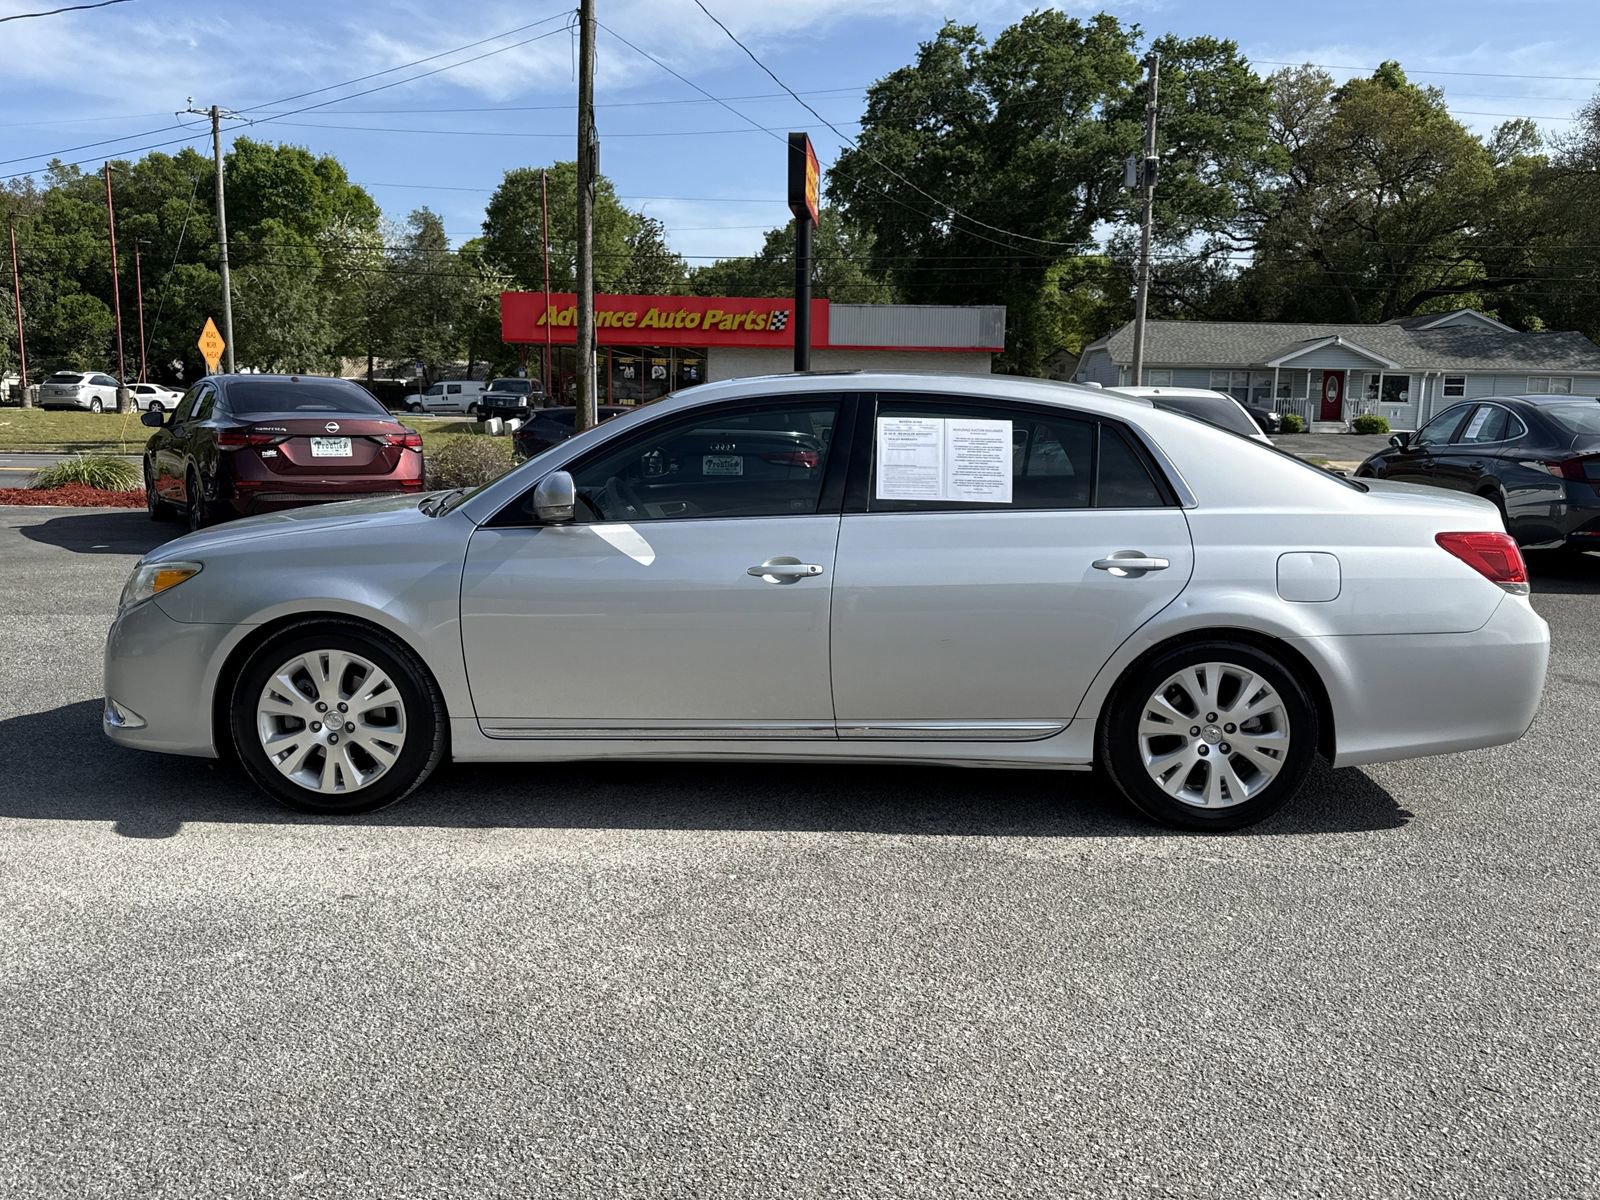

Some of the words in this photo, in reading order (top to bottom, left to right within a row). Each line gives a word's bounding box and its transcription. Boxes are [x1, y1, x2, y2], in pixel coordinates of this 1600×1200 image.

[536, 305, 638, 328] Adnce
[639, 307, 700, 329] Auto
[702, 309, 768, 331] Parts
